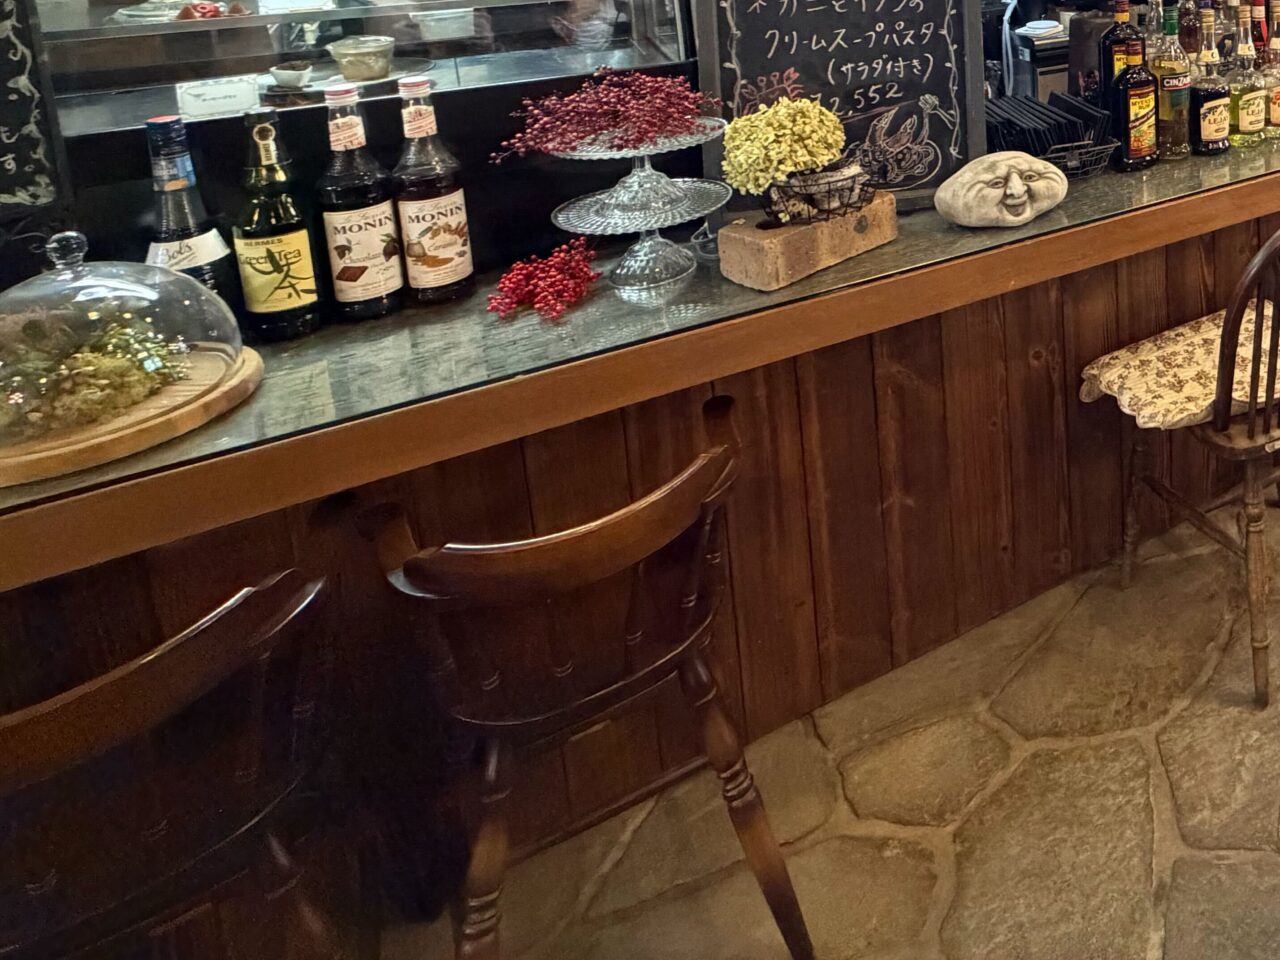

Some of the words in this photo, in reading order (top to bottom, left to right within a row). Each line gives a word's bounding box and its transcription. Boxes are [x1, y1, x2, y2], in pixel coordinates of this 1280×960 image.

[765, 21, 935, 59] クリームスープパスタ
[333, 213, 393, 236] MONIN
[408, 202, 463, 224] MONIN
